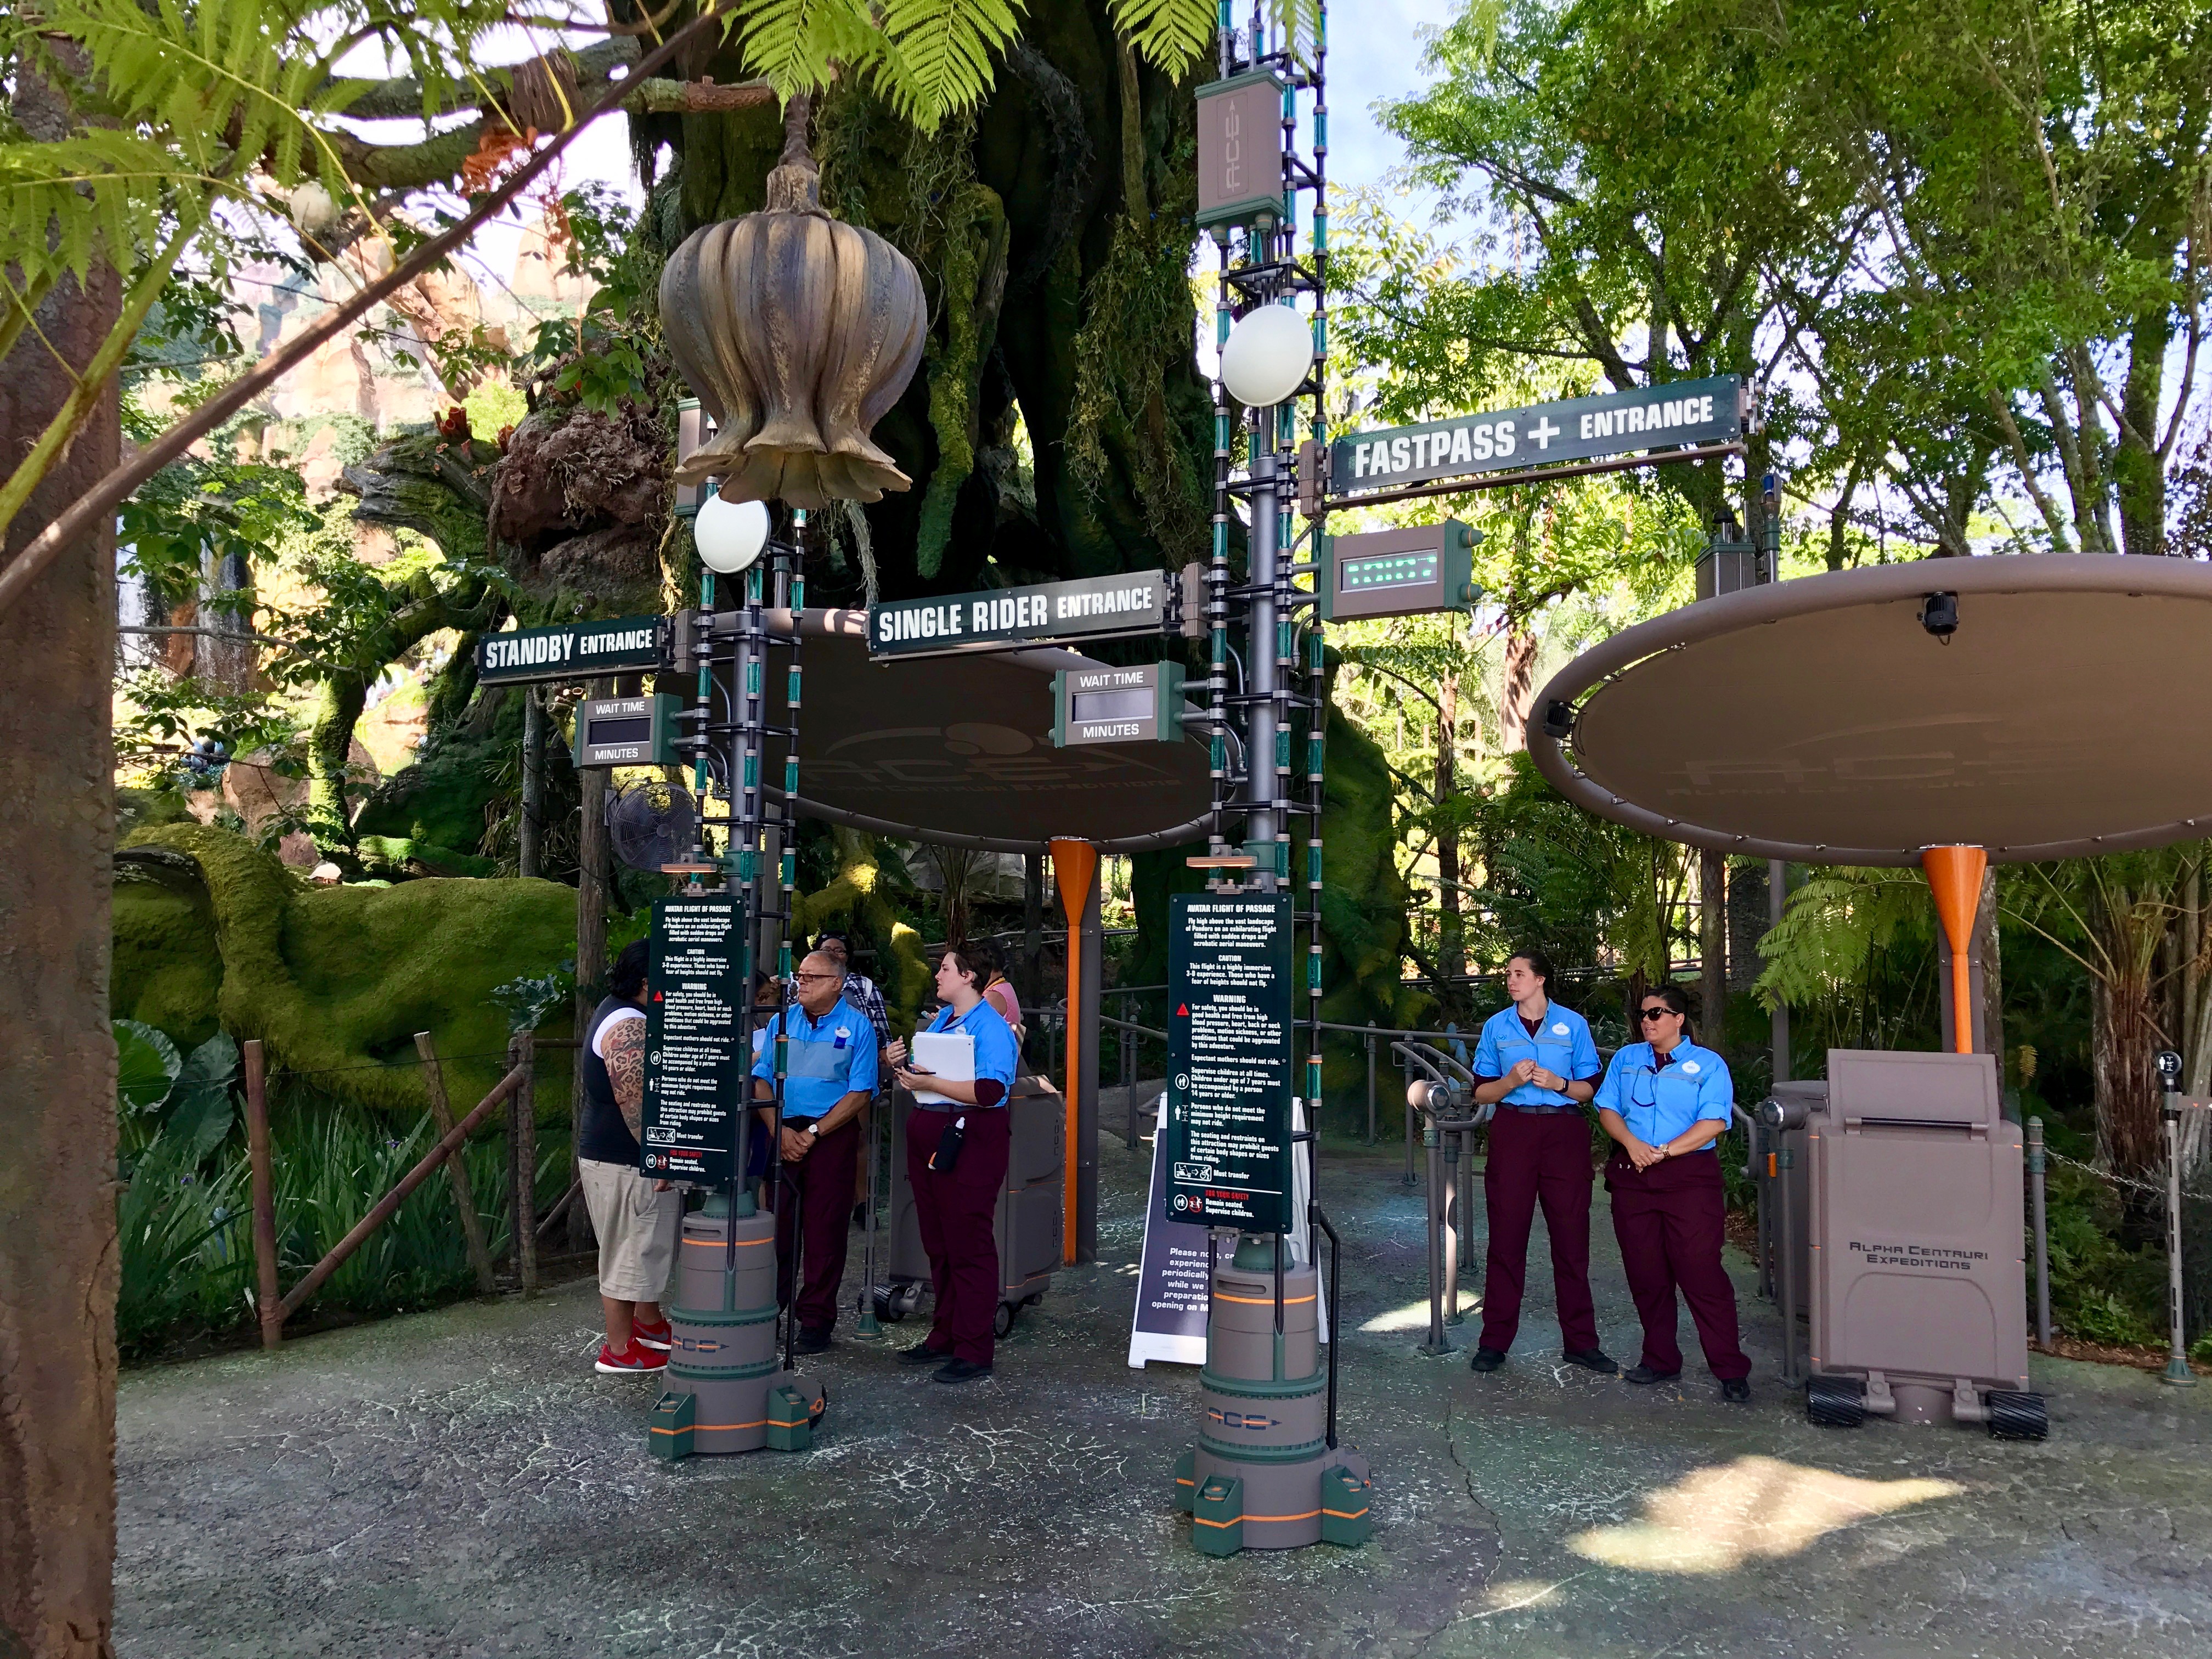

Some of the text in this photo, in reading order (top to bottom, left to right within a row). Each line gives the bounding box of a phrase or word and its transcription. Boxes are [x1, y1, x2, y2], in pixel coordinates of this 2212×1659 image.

[1355, 420, 1515, 478] FASTPASS
[1580, 396, 1713, 440] ENTRANCE
[879, 586, 1152, 642] SINGLE RIDER ENTRANCE
[486, 629, 653, 668] STANDBY ENTRANCE
[1080, 671, 1144, 687] WAIT TIME
[596, 701, 645, 715] WAIT TIME
[1082, 724, 1139, 738] MINUTES
[595, 747, 639, 760] MINUTES
[1212, 904, 1234, 912] FLIGHT
[1235, 904, 1244, 912] OF
[1229, 925, 1261, 933] exhilarating
[1196, 970, 1227, 979] experience.
[1213, 994, 1246, 1003] WARNING
[1192, 1011, 1204, 1019] good
[1191, 1041, 1197, 1049] by
[1191, 1054, 1216, 1063] Expectant
[1191, 1066, 1216, 1075] Supervise
[1200, 1131, 1219, 1140] seating
[1231, 1133, 1257, 1142] restraints
[1203, 1154, 1220, 1164] riding.
[1228, 1171, 1249, 1179] transfer
[1225, 1200, 1244, 1208] seated.
[1205, 1206, 1254, 1217] Supervise children.
[1170, 1247, 1197, 1256] Please
[1849, 1242, 1989, 1260] ALPHA CENTAURI
[1170, 1260, 1209, 1268] experienc
[1866, 1254, 1971, 1270] EXPEDITIONS
[1162, 1269, 1209, 1280] periodically
[1167, 1280, 1189, 1289] while
[1164, 1291, 1209, 1301] preparatio
[1152, 1301, 1183, 1311] opening
